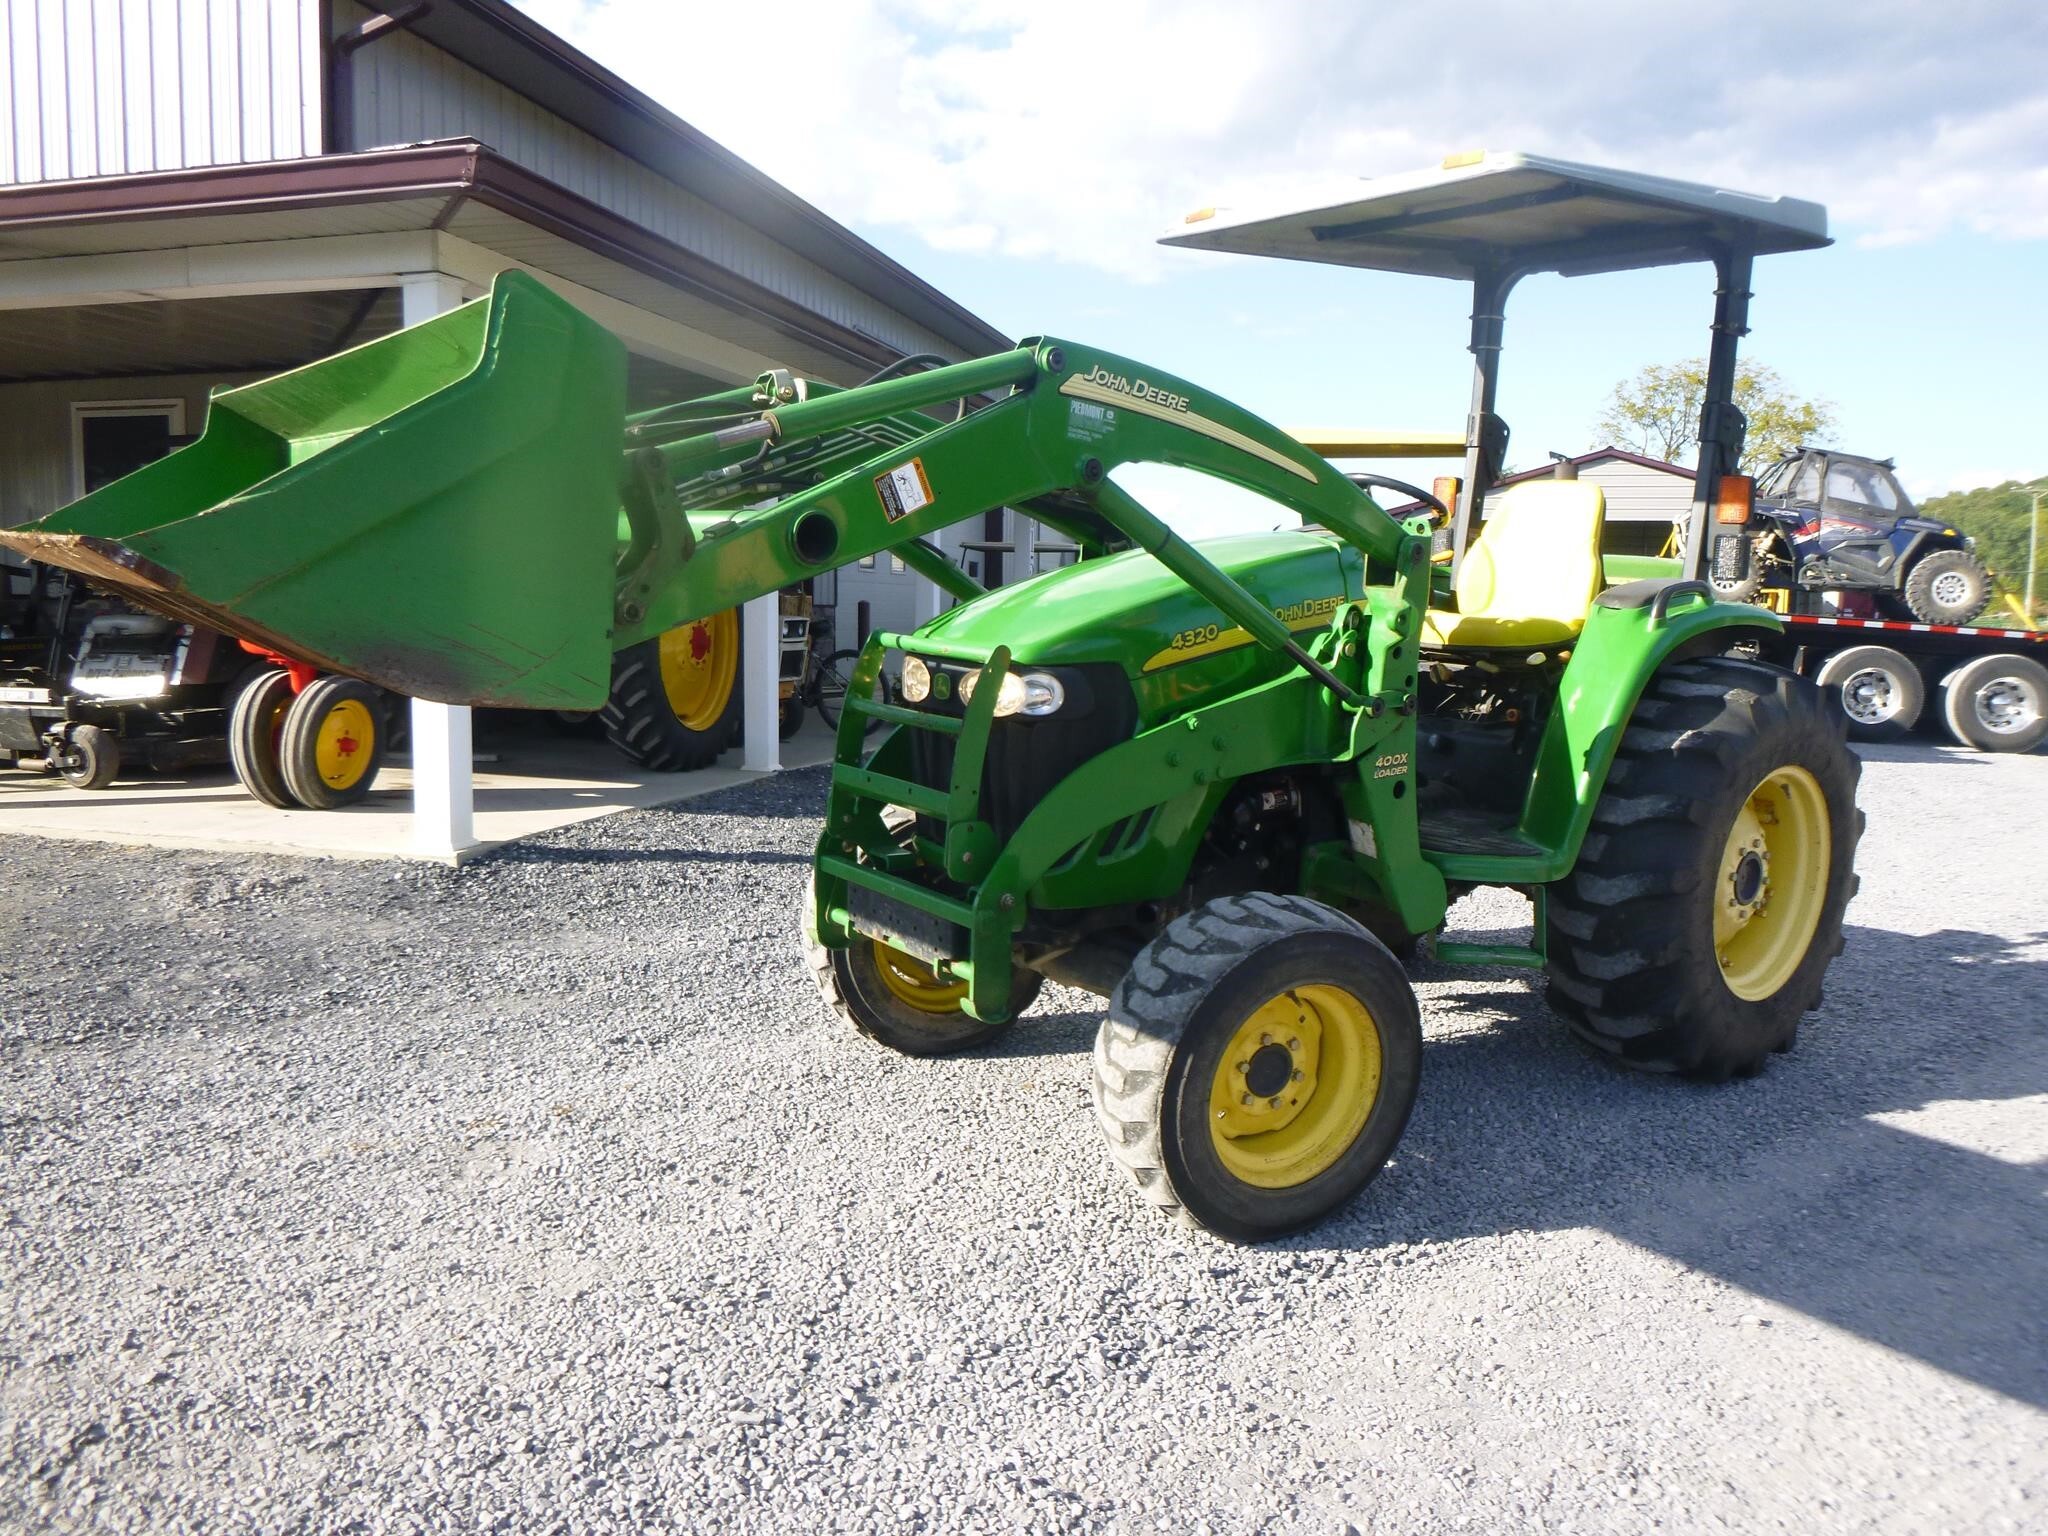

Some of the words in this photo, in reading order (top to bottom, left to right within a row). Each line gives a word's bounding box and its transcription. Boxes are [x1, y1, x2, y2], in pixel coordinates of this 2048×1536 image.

[1083, 364, 1131, 394] JOHN
[1132, 379, 1190, 412] DEERE
[1272, 604, 1303, 621] OHN
[1171, 624, 1218, 650] 4320
[1375, 753, 1409, 768] 400X
[1373, 765, 1408, 779] LOADER
